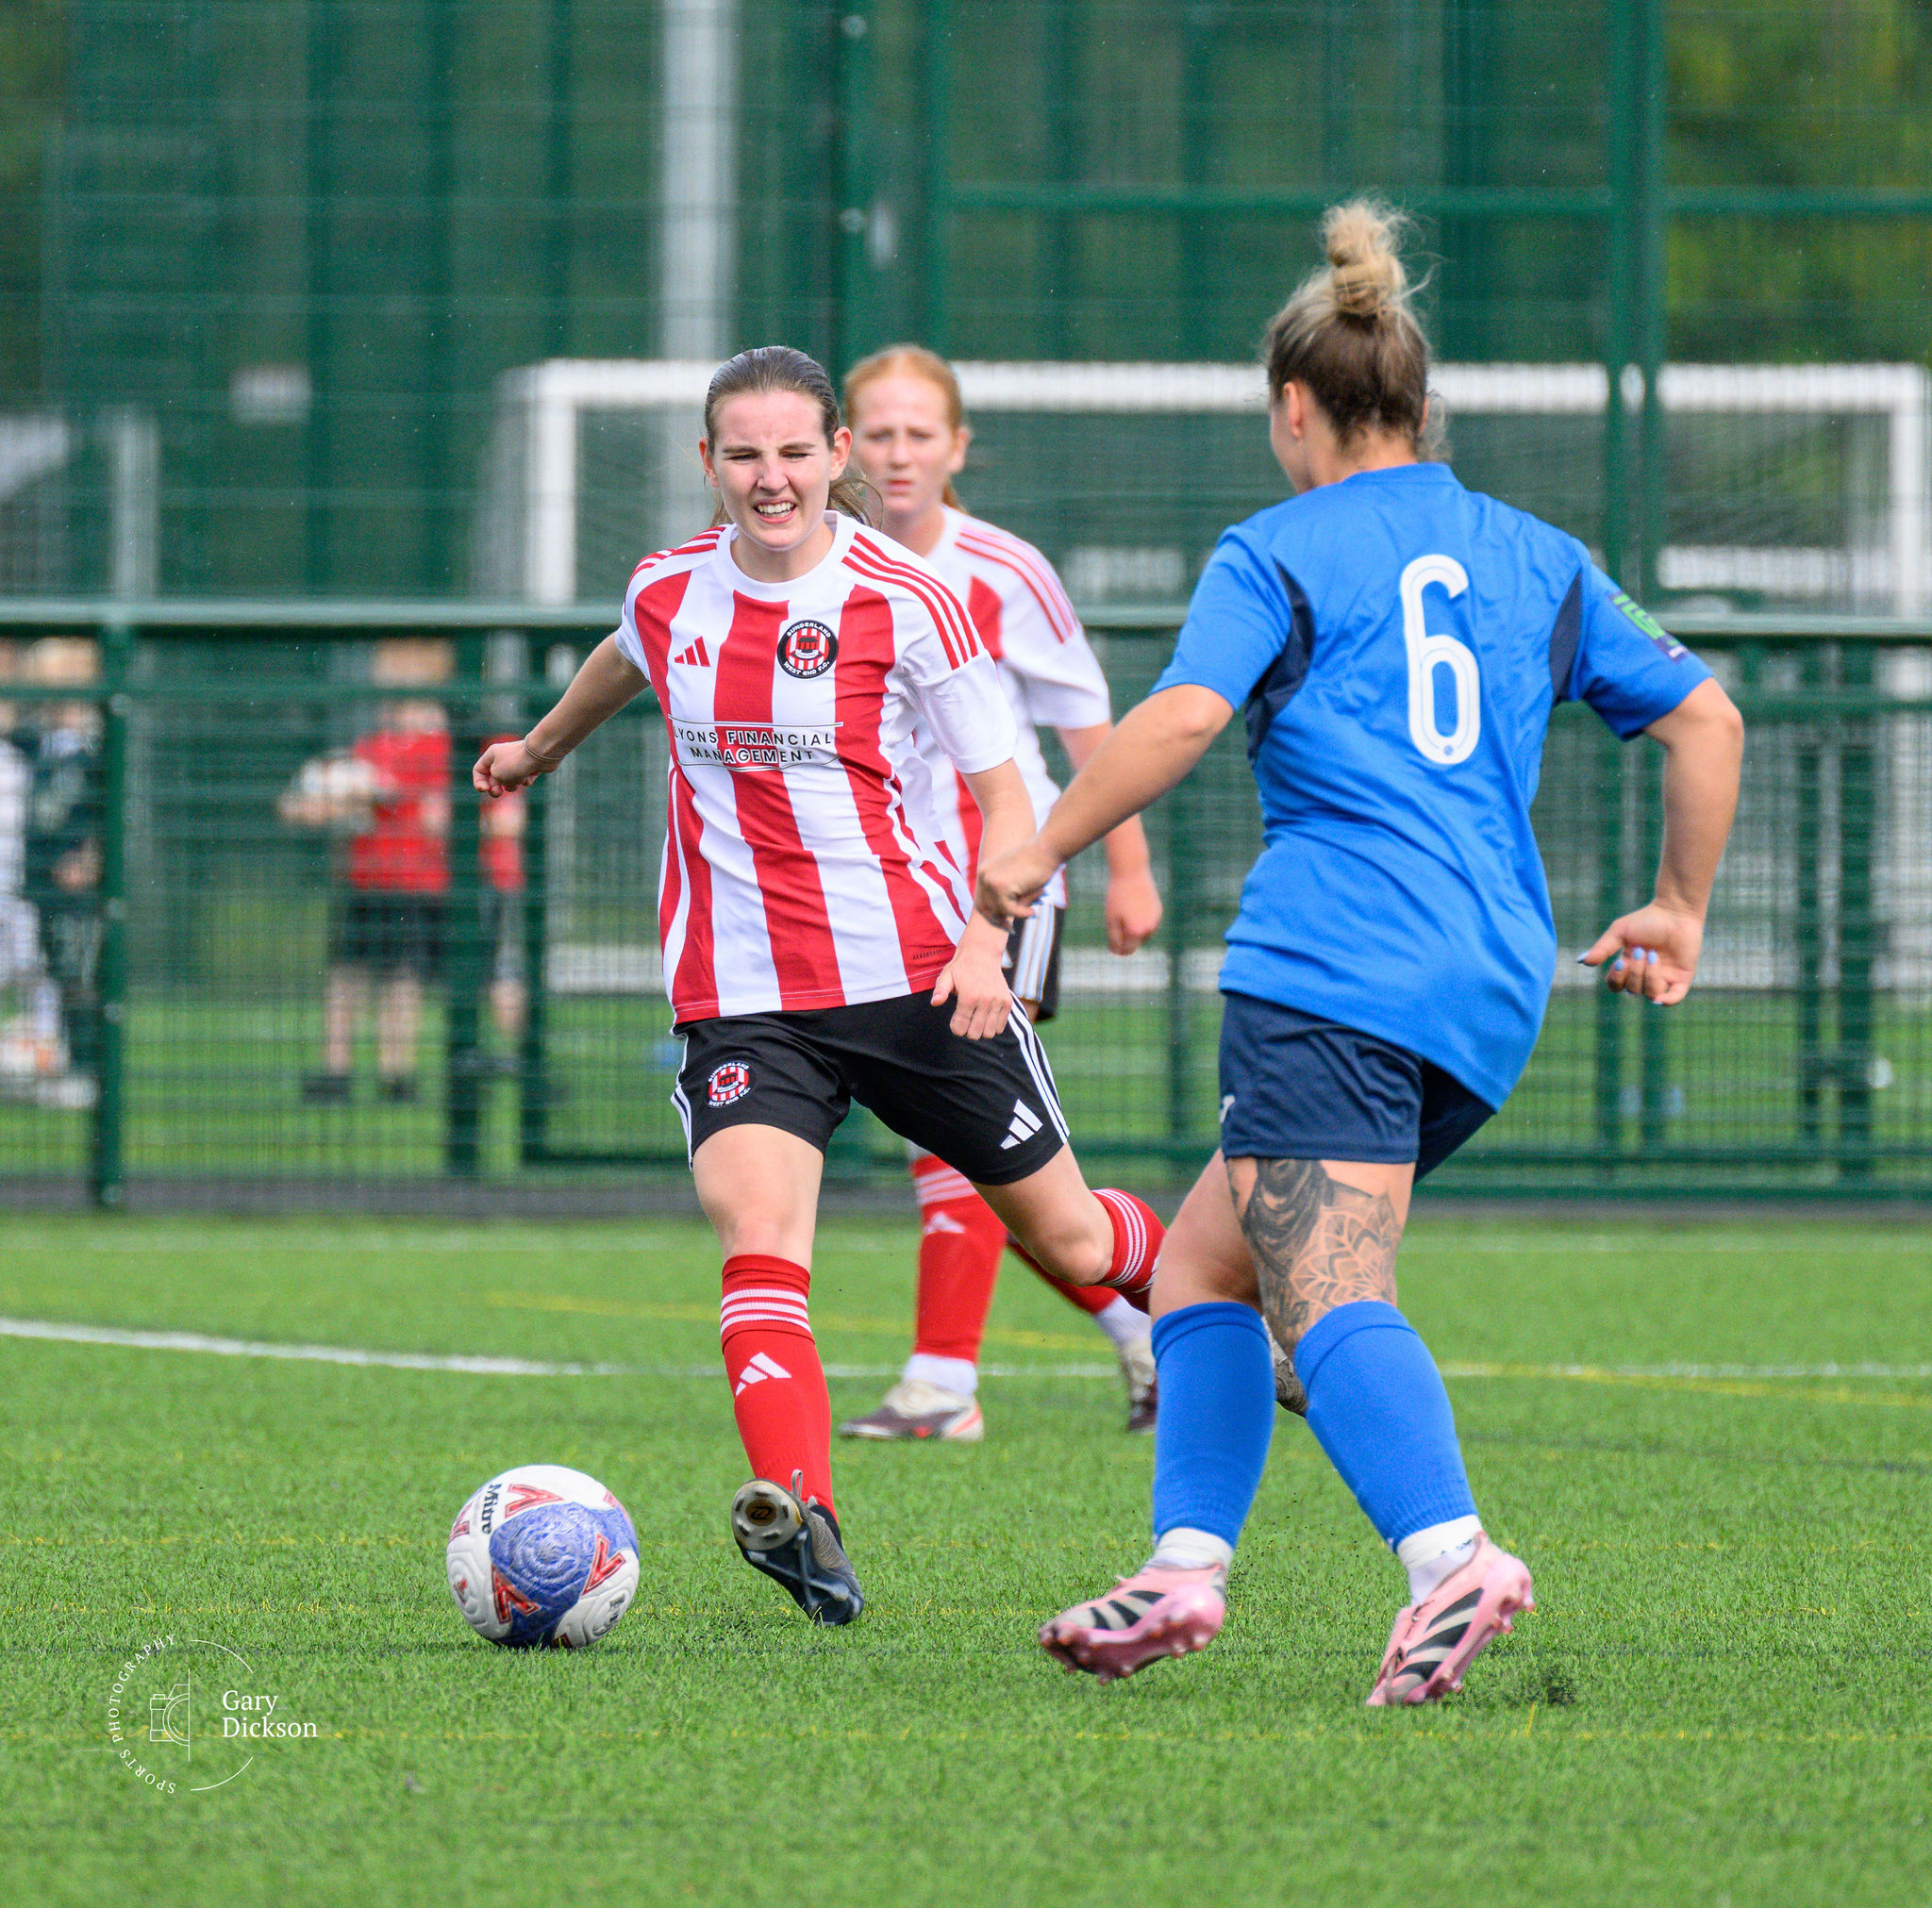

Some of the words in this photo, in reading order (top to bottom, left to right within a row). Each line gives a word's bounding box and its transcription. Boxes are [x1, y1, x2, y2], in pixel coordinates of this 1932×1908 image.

[787, 622, 831, 638] SUNDERLAND
[1400, 554, 1481, 764] 6
[784, 661, 802, 675] WEST
[674, 727, 718, 744] LYONS
[726, 730, 831, 746] FINANCIAL
[690, 747, 813, 763] MANAGEMENT
[481, 1483, 503, 1535] Mitre
